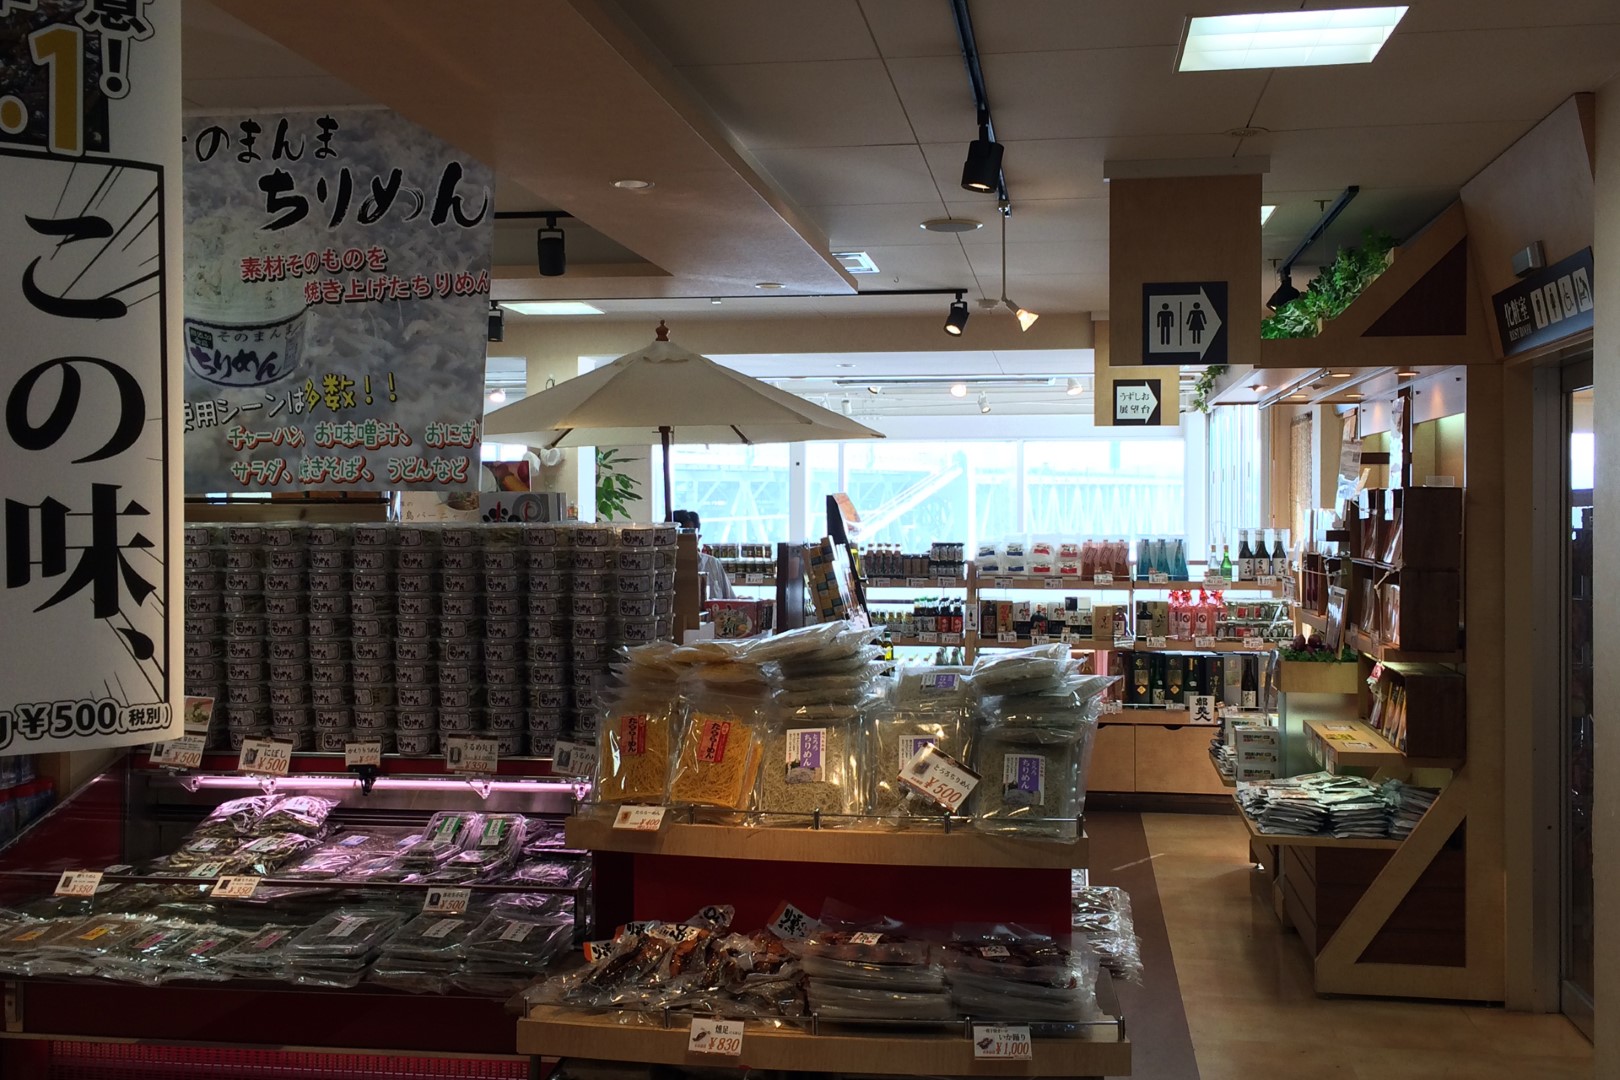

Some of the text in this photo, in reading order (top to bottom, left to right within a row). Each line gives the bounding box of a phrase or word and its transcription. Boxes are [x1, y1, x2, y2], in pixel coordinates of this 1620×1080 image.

[184, 115, 338, 162] のまんま
[258, 161, 488, 231] ちりめん
[241, 245, 387, 282] 素材そのものを
[304, 269, 490, 304] 焼き上げたちりめん
[1504, 296, 1530, 328] 化粧室
[190, 346, 282, 381] ちりめん
[1119, 391, 1150, 401] うずしお
[1119, 404, 1150, 414] 展望台
[314, 419, 413, 447] お味噌汁、
[386, 456, 468, 481] うどんなど
[173, 751, 201, 764] ¥500
[264, 749, 286, 758] にぼし
[802, 734, 812, 767] ちりめん
[258, 756, 287, 772] ¥500
[465, 761, 487, 769] ¥350
[1021, 759, 1031, 789] ちりめん
[933, 763, 971, 790] とろろちりめん
[924, 775, 963, 803] ¥500
[639, 818, 660, 826] ¥400
[71, 884, 94, 894] ¥350
[228, 886, 253, 895] ¥350
[440, 899, 466, 910] ¥500
[708, 1037, 740, 1052] ¥830
[995, 1041, 1029, 1056] ¥1,000
